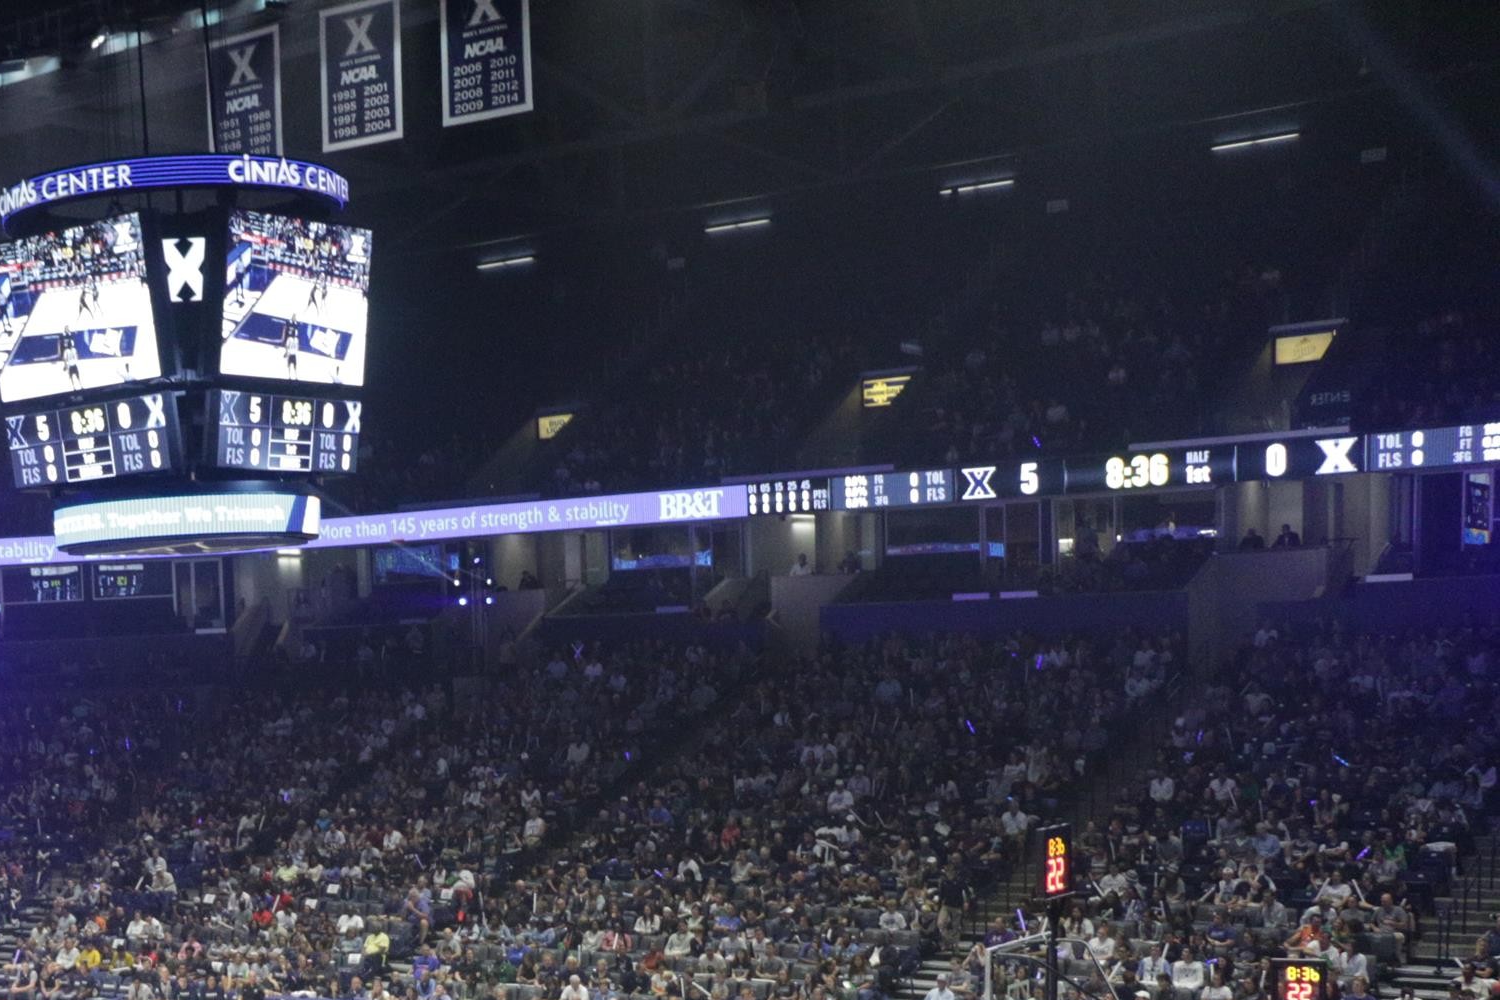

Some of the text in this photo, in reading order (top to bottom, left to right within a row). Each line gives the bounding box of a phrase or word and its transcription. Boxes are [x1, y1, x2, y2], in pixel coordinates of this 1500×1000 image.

[343, 13, 376, 56] X
[464, 36, 506, 60] NCAA
[228, 44, 260, 86] X
[453, 61, 482, 77] 2006
[490, 54, 517, 69] 2010
[340, 64, 377, 86] NCAA
[454, 74, 482, 90] 2007
[490, 68, 515, 81] 2011
[364, 81, 388, 96] 2001
[454, 87, 484, 102] 2008
[490, 79, 519, 94] 2012
[226, 93, 260, 115] NCAA
[364, 93, 390, 109] 2002
[455, 99, 484, 115] 2009
[492, 92, 519, 106] 2014
[333, 112, 357, 127] 1997
[364, 106, 390, 121] 2003
[365, 118, 391, 133] 2004
[41, 164, 133, 200] CENTER
[161, 237, 206, 303] X
[35, 414, 50, 441] 5
[116, 402, 132, 429] 0
[139, 393, 166, 429] X
[249, 396, 262, 424] 5
[322, 402, 334, 429] 0
[343, 400, 362, 433] X
[18, 429, 159, 466] TOL 0 TOL 0
[226, 427, 244, 445] TOL
[251, 428, 261, 447] 0
[320, 434, 336, 451] TOL
[342, 434, 352, 452] 0
[1377, 425, 1473, 450] TOL 0 FG
[1459, 438, 1472, 450] FT
[22, 467, 41, 485] FLS
[46, 464, 57, 482] 0
[123, 453, 143, 472] FLS
[150, 449, 161, 468] 0
[226, 448, 244, 465] FLS
[250, 448, 260, 466] 0
[319, 453, 336, 469] FLS
[341, 453, 350, 471] 0
[961, 436, 1359, 500] X 5 8:36 HALF 0 X
[1378, 449, 1472, 468] FLS 0 3FG
[909, 471, 946, 488] 0 TOL
[1185, 464, 1211, 485] 1st
[775, 482, 784, 492] 15
[909, 488, 946, 503] 0 FLS
[183, 507, 212, 523] We
[214, 505, 285, 525] Triumph
[658, 490, 723, 520] BB&T
[355, 520, 387, 539] than
[390, 517, 417, 535] 145
[419, 516, 459, 539] years
[462, 510, 478, 529] of
[480, 504, 544, 531] strength
[548, 505, 561, 522] &
[565, 500, 630, 523] stability
[1046, 857, 1064, 893] 22
[1286, 966, 1320, 982] 8:36
